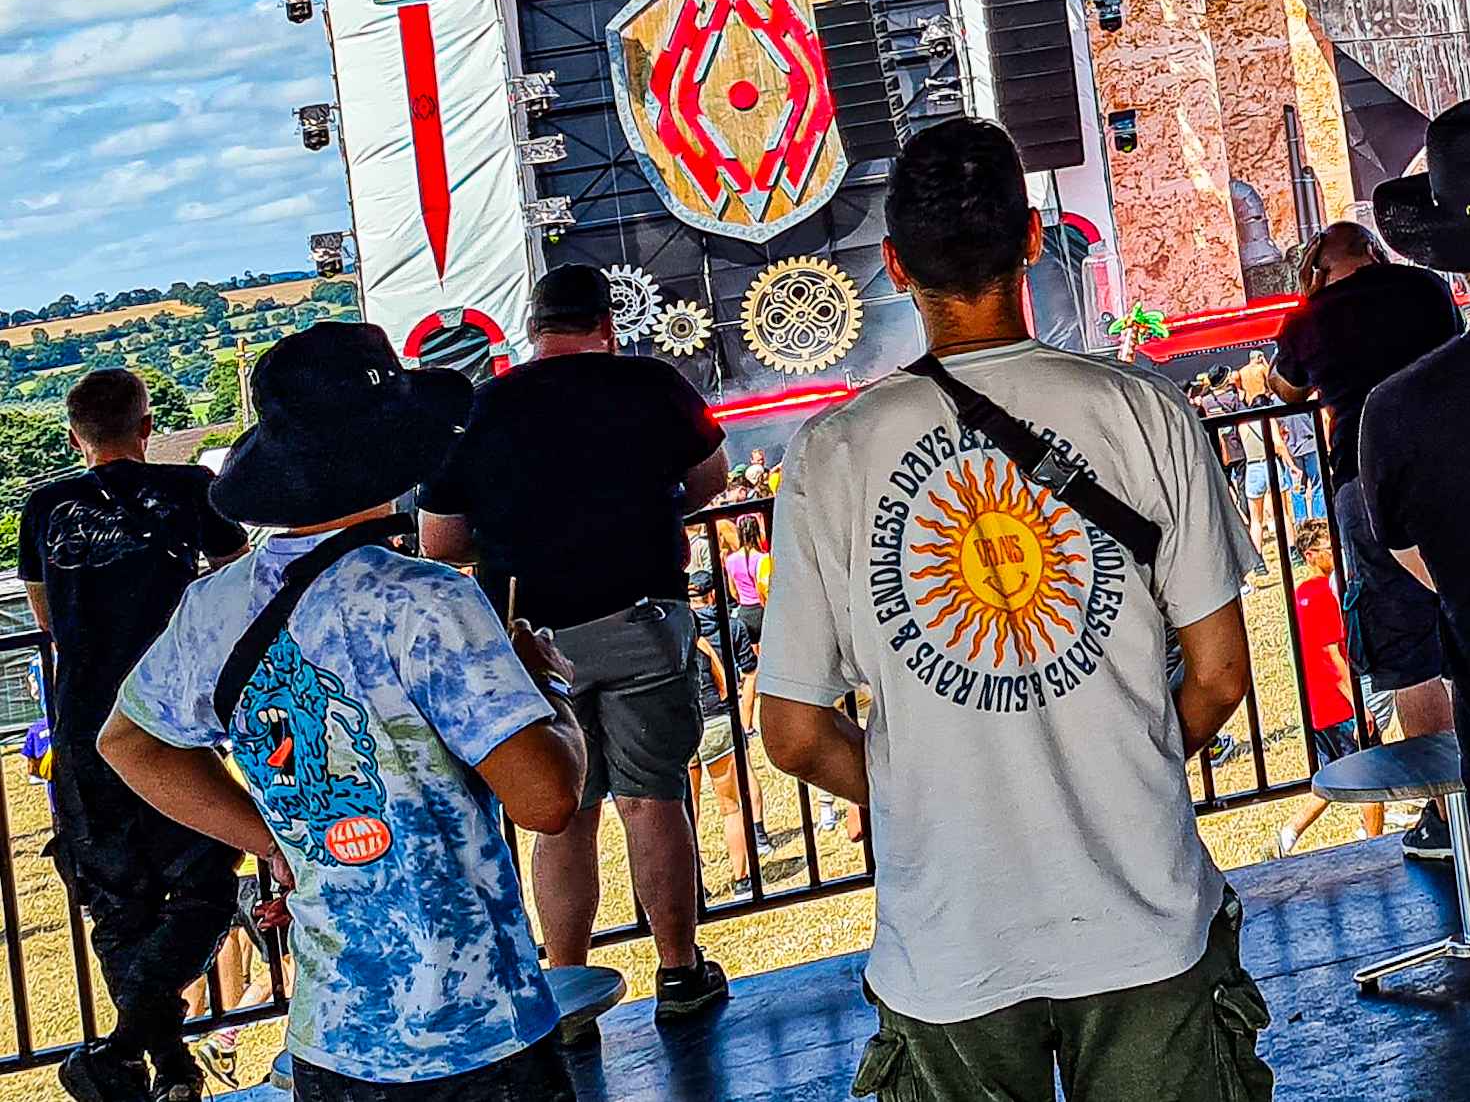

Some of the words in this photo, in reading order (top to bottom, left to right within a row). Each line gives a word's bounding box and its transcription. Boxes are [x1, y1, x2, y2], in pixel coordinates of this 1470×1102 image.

[889, 426, 956, 498] DAYS
[870, 495, 911, 625] ENDLESS
[1086, 526, 1125, 637] ENDLESS
[889, 618, 921, 651] &
[1045, 627, 1104, 697] DAYS
[906, 642, 978, 706] RAYS
[976, 674, 1028, 712] SUN
